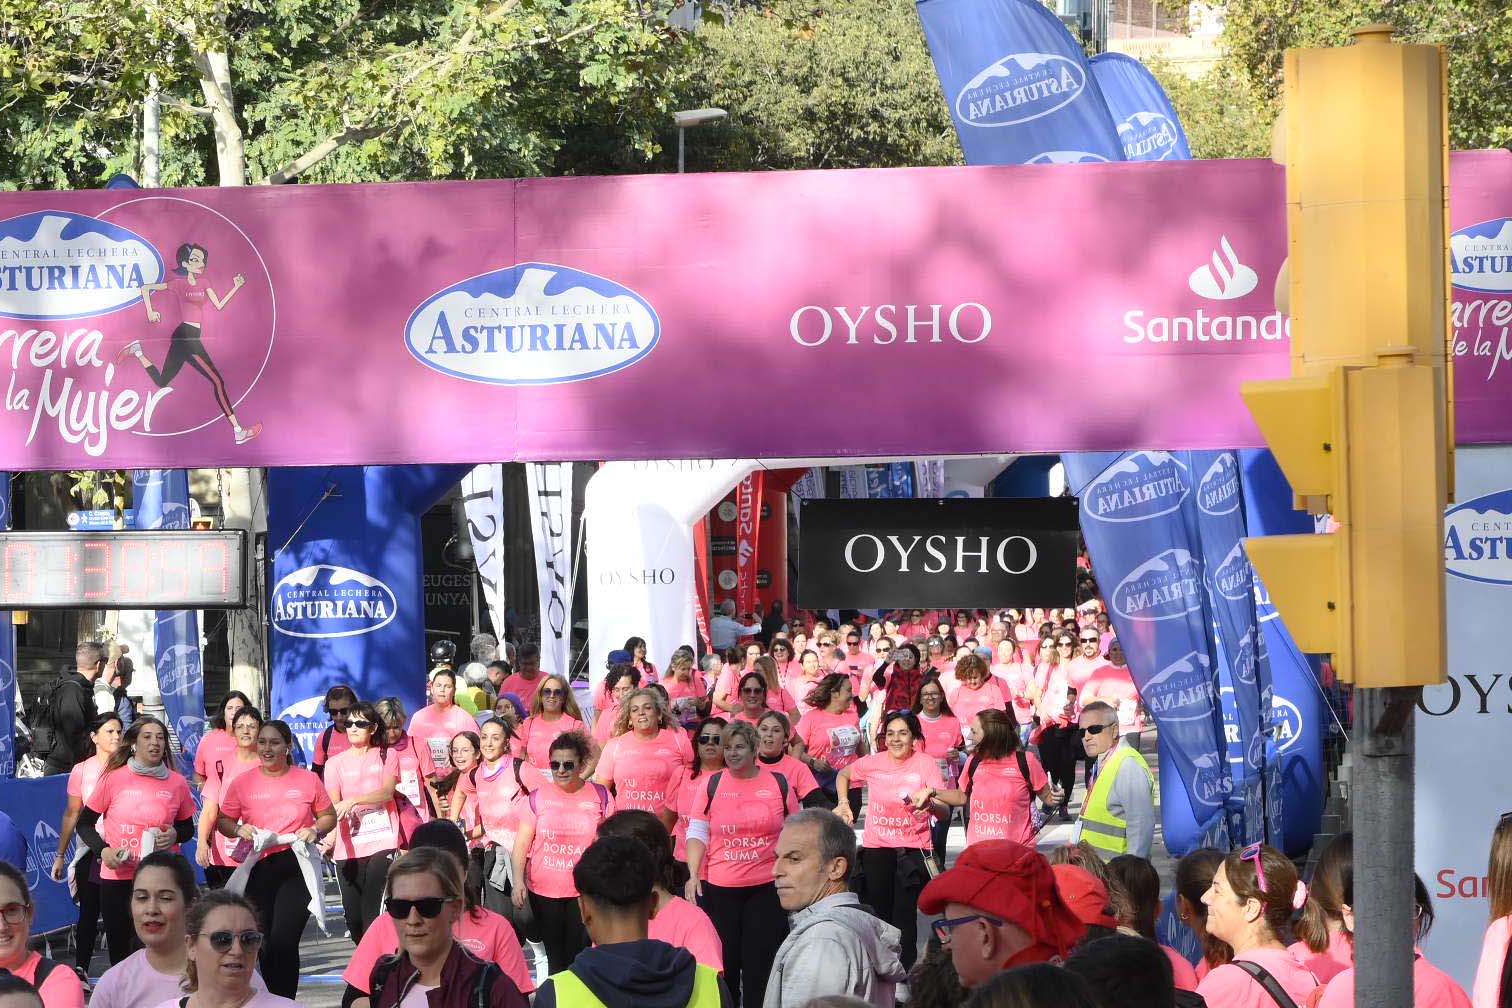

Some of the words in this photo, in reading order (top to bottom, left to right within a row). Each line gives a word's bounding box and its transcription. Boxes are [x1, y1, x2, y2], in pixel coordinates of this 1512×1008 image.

[65, 247, 139, 259] LECHERA
[464, 306, 541, 319] CENTRAL
[551, 302, 632, 316] LECHERA
[789, 302, 992, 347] OYSHO
[425, 311, 640, 355] ASTURIANA
[1123, 310, 1291, 344] Santand
[1473, 328, 1492, 356] la
[6, 371, 30, 411] la
[26, 363, 174, 457] Mujer
[844, 534, 1038, 575] OYSHO
[287, 590, 328, 598] CENTRAL
[334, 589, 383, 597] LECHERA
[274, 598, 388, 621] ASTURIANA
[975, 825, 1004, 836] SUMA
[724, 849, 760, 861] SUMA
